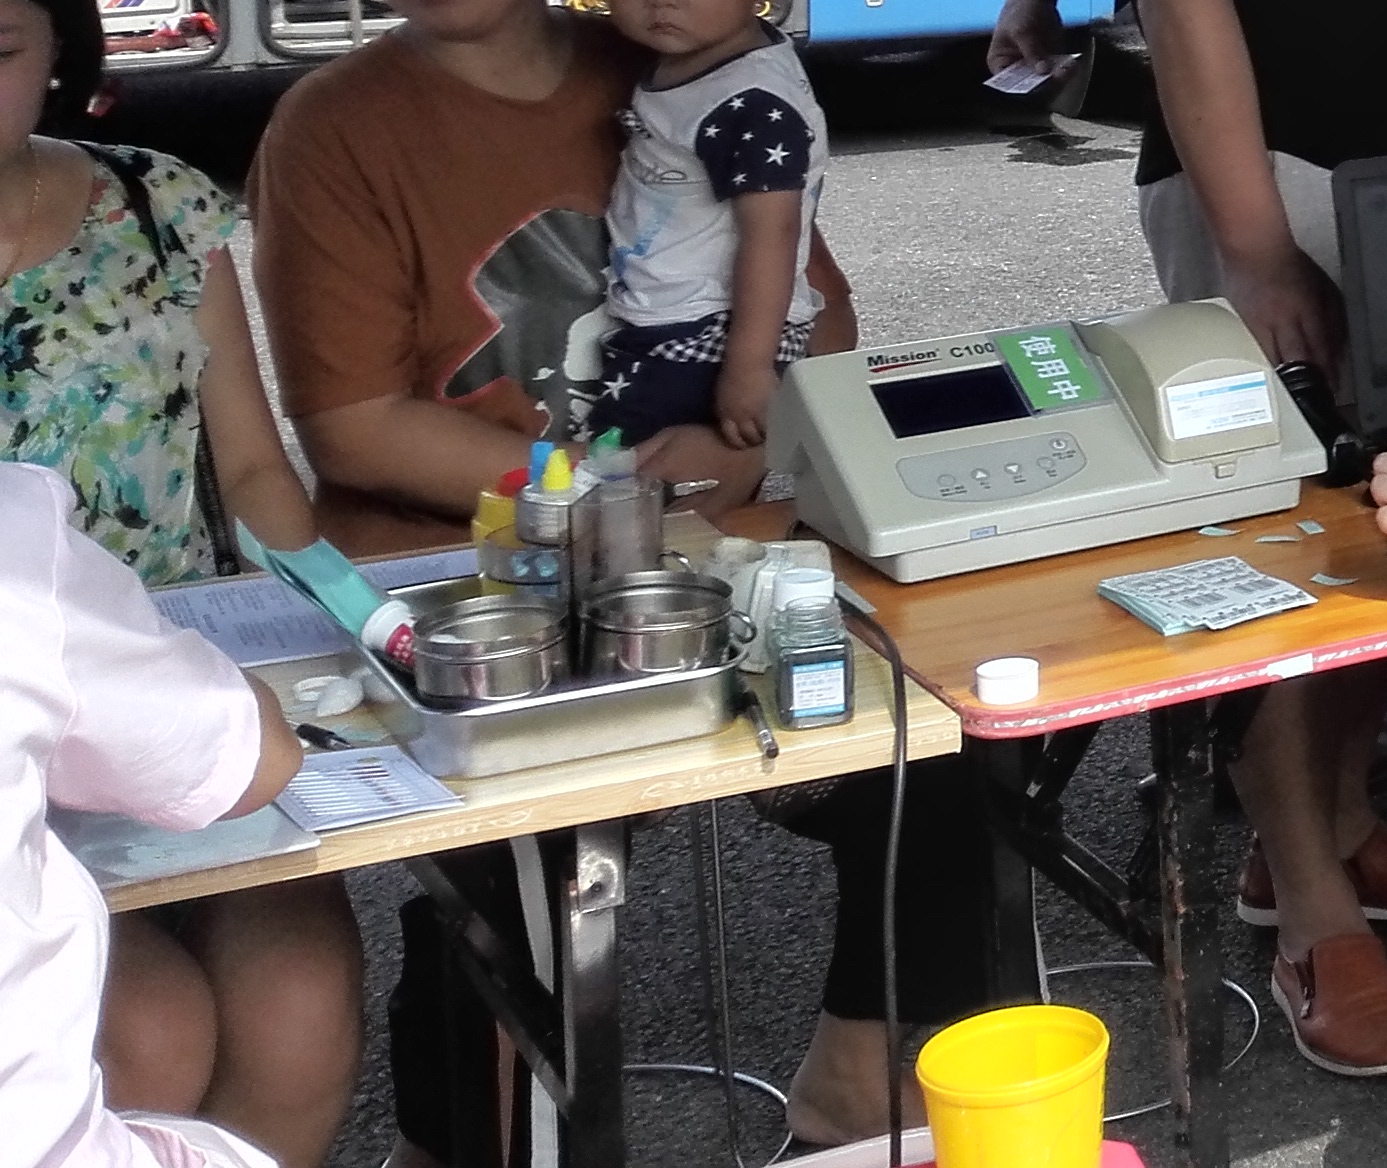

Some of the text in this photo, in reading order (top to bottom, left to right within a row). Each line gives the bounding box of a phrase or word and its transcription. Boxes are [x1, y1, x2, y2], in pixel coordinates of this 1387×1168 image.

[867, 342, 995, 368] Mission C100
[1018, 334, 1082, 401] 使用中
